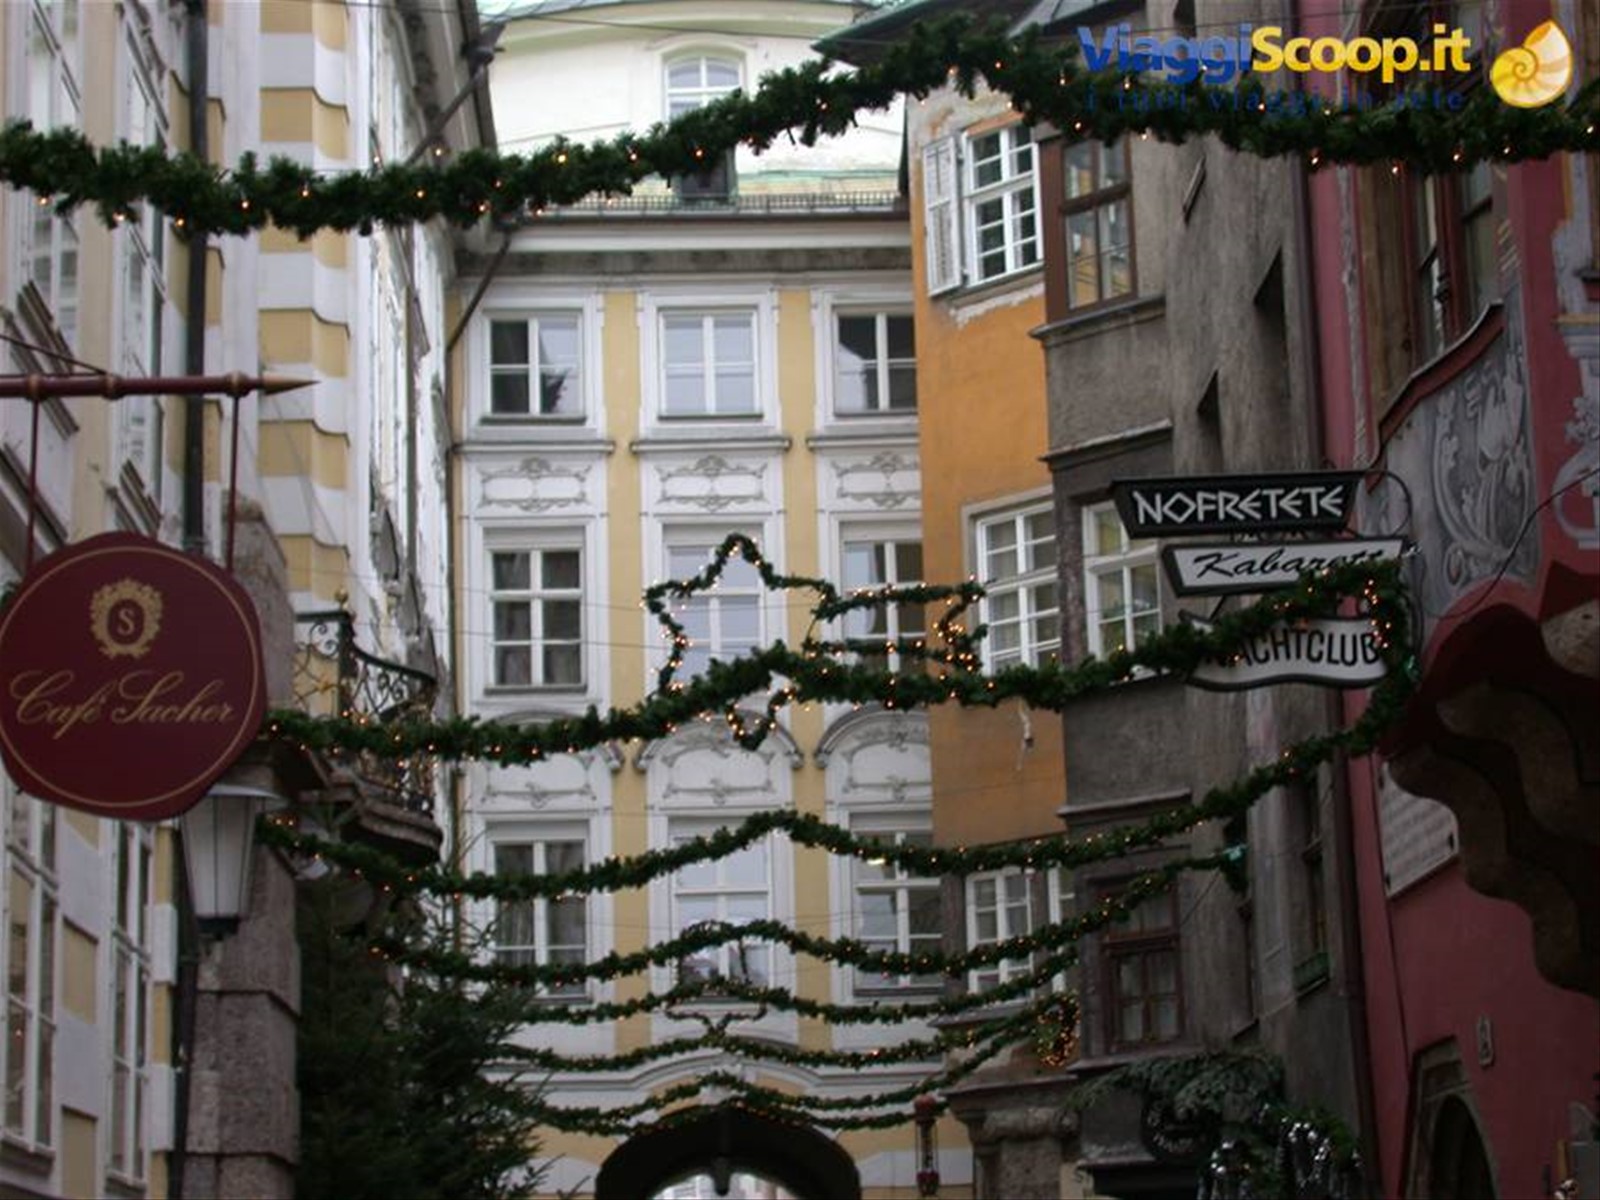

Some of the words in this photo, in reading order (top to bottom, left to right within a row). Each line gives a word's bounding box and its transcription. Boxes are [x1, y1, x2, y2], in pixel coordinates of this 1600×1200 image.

[1133, 486, 1343, 525] NOFRETETE
[117, 608, 136, 636] S
[1222, 628, 1379, 667] CHTCLUB
[10, 670, 117, 740] Café
[112, 670, 236, 725] Sacher
